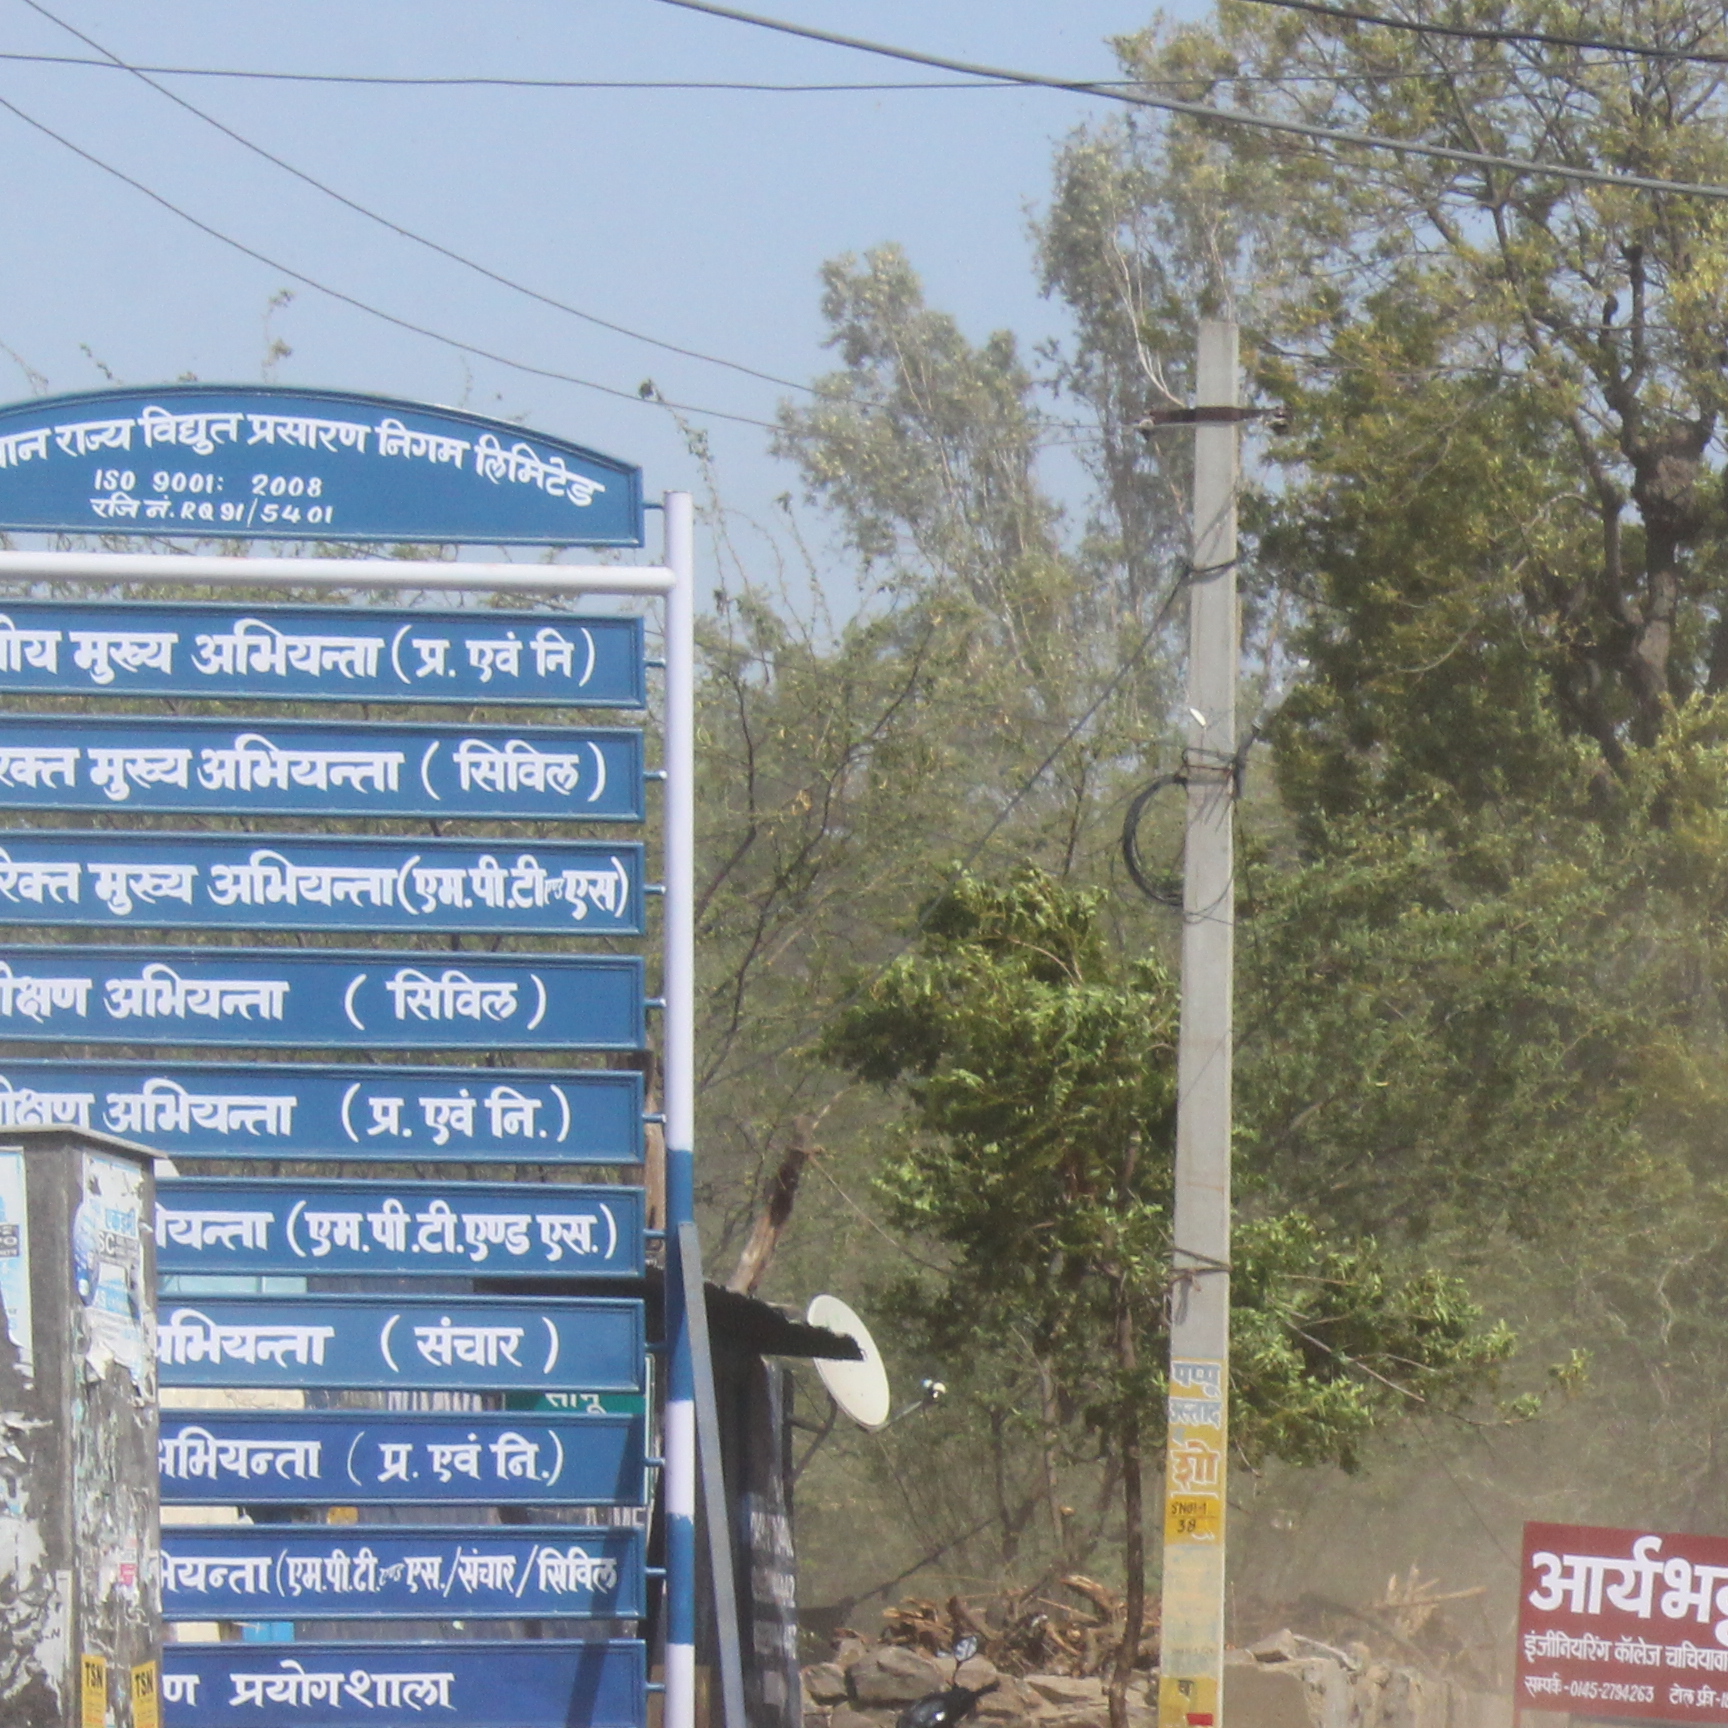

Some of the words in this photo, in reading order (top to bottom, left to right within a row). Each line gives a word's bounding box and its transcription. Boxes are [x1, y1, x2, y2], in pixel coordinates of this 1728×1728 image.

[54, 418, 136, 457] राज्य
[137, 406, 244, 455] विद्युत
[247, 413, 371, 453] प्रसारण
[374, 418, 471, 469] निगम
[474, 434, 606, 506] लिमिटेड
[94, 469, 136, 491] ISO
[152, 471, 225, 493] 9001:
[251, 474, 323, 498] 2008
[90, 491, 140, 519] रजि
[69, 631, 179, 684] मुख्य
[191, 618, 385, 678] अभियन्ता
[465, 631, 523, 683] एवं
[88, 748, 192, 801] मुख्य
[197, 733, 405, 794] अभियन्ता
[87, 862, 199, 915] मुख्य
[207, 850, 399, 907] अभियन्ता
[104, 963, 290, 1020] अभियन्ता
[103, 1077, 297, 1136] अभियन्ता
[419, 1088, 476, 1145] एवं
[427, 1432, 482, 1483] एवं
[1614, 1635, 1663, 1667] कॉलेज
[229, 1659, 457, 1710] प्रयोगशाला
